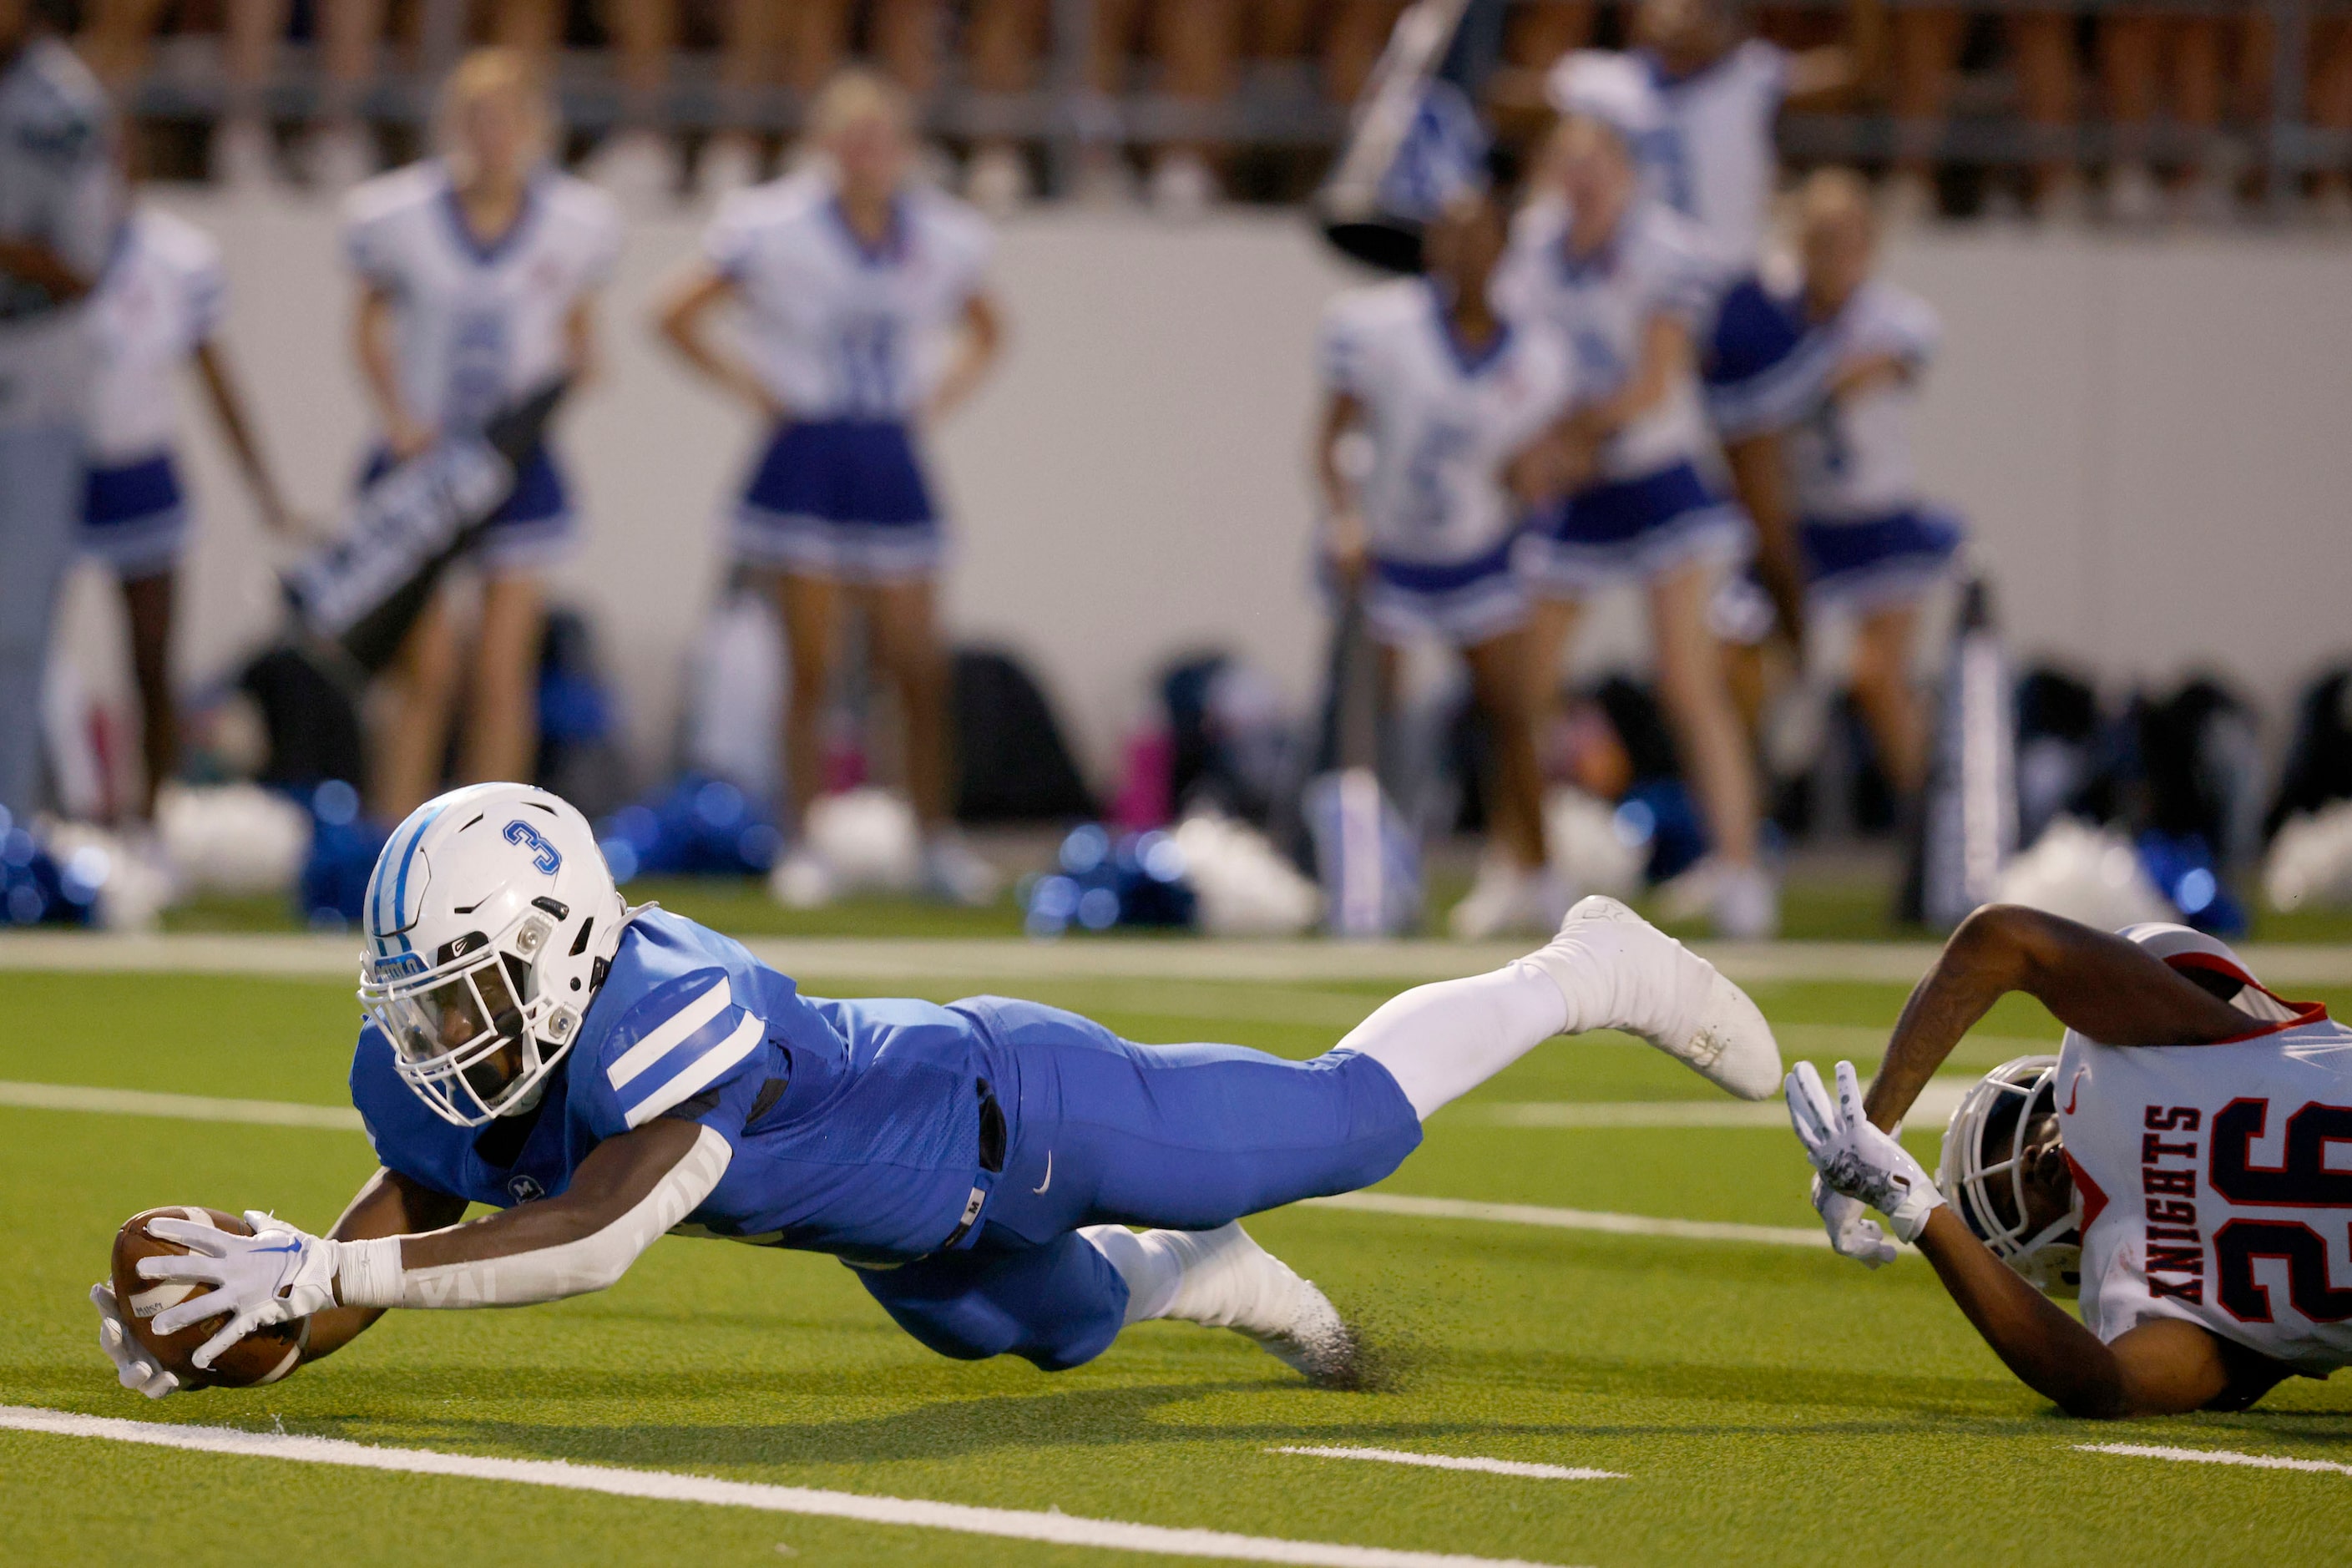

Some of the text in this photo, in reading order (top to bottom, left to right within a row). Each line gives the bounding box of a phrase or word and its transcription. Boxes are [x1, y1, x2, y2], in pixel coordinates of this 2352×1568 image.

[503, 820, 562, 875] 3
[969, 1201, 979, 1214] M
[2142, 1105, 2203, 1306] KNIGHTS
[2208, 1097, 2352, 1323] 26
